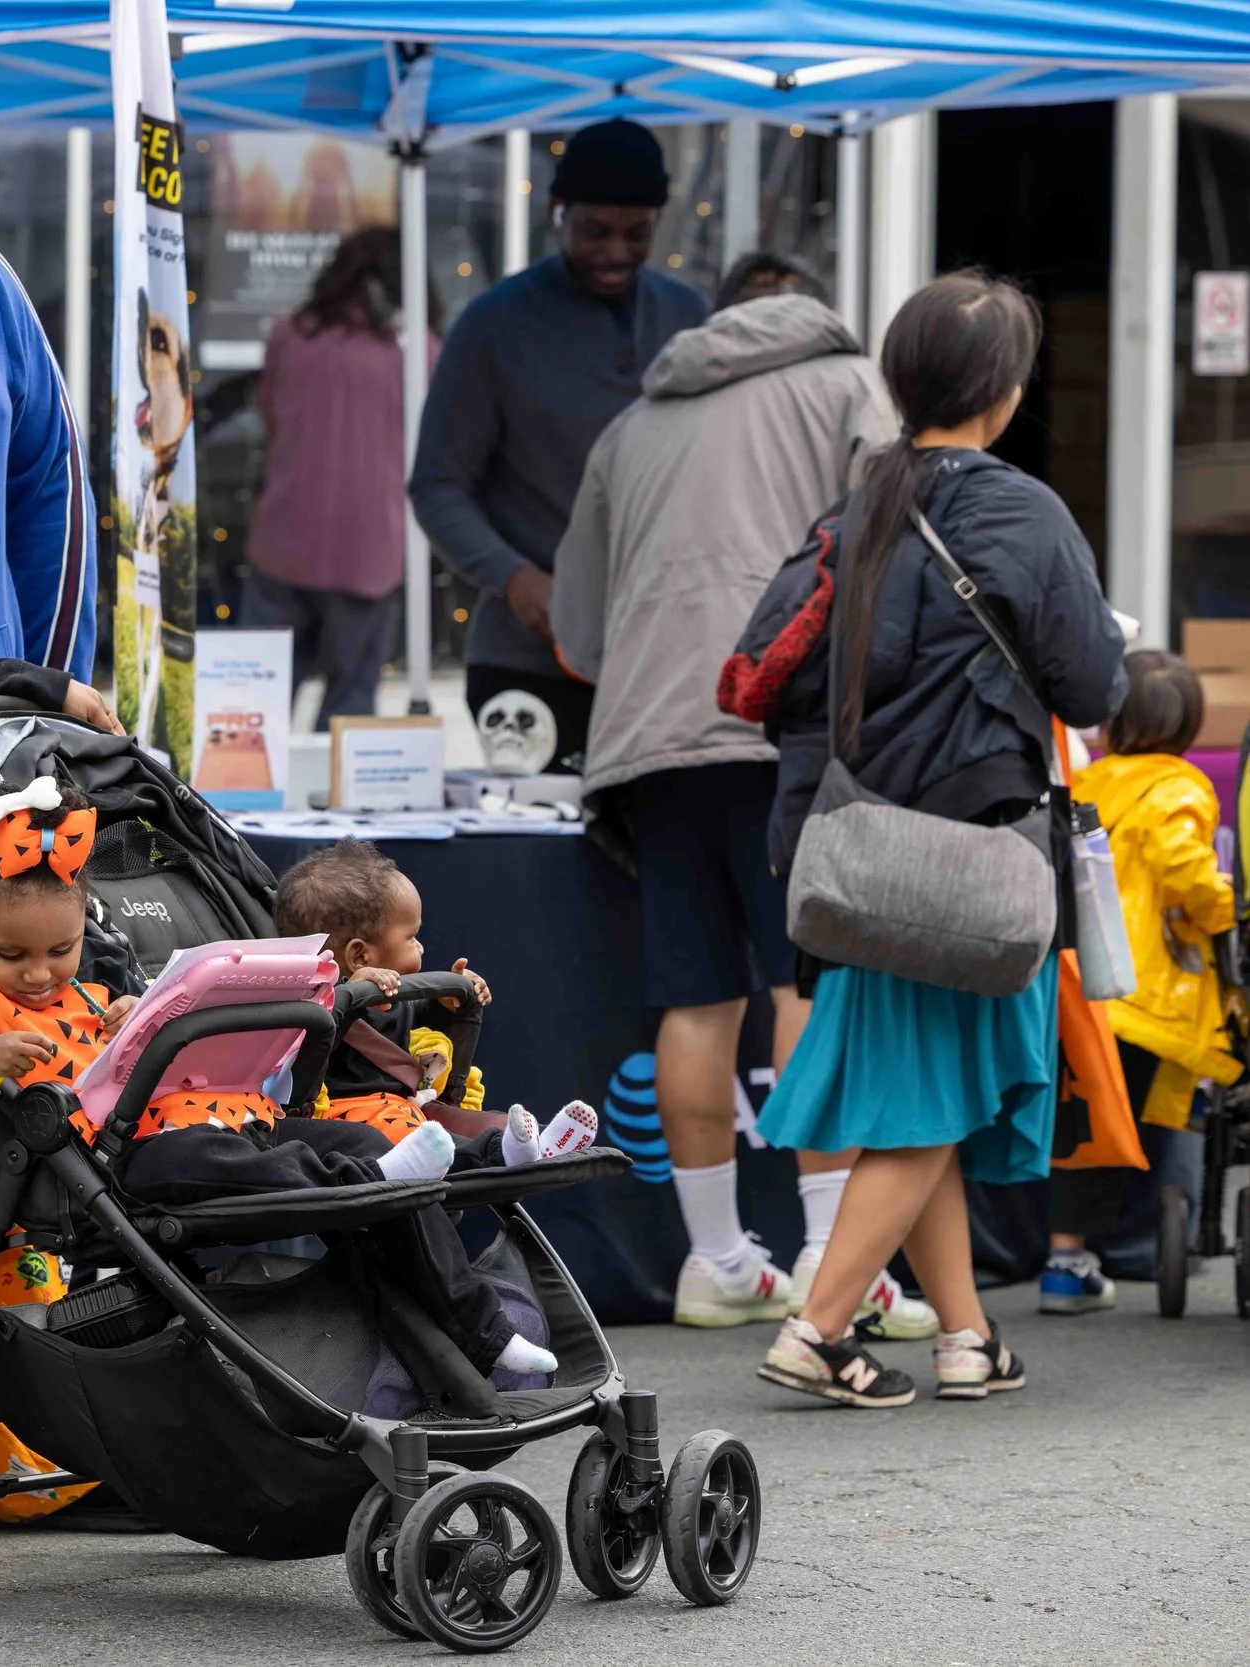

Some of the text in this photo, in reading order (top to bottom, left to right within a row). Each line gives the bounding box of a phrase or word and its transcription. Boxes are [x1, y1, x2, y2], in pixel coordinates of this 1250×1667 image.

[141, 154, 182, 205] CO
[555, 1127, 575, 1150] Hanes
[839, 1355, 879, 1393] N
